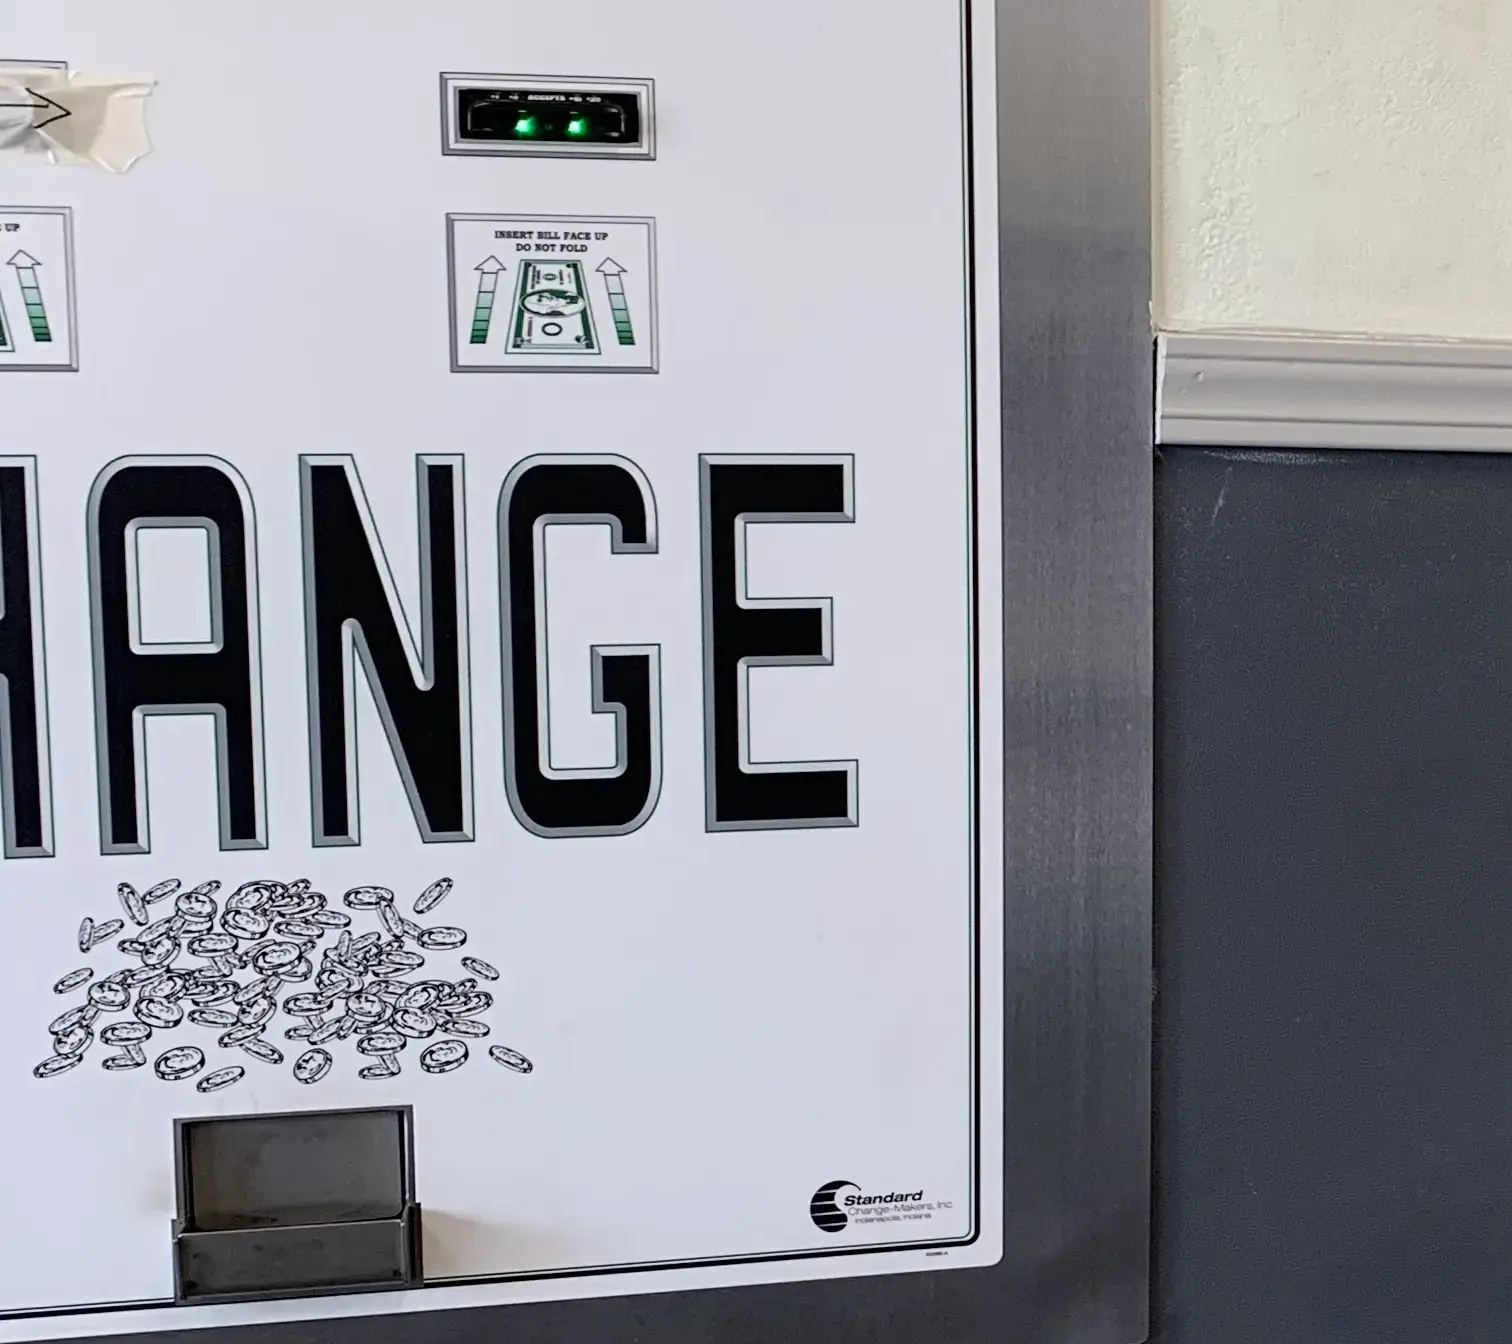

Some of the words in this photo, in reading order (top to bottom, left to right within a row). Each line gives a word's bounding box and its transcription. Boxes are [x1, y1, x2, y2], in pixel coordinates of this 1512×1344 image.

[4, 223, 20, 232] UP
[494, 230, 534, 239] INSERT
[537, 231, 561, 240] BILL
[563, 232, 592, 240] FACE
[594, 232, 609, 241] UP
[516, 243, 531, 252] DO
[535, 244, 556, 252] NOT
[560, 244, 588, 253] FOLD
[844, 1190, 923, 1206] Standard
